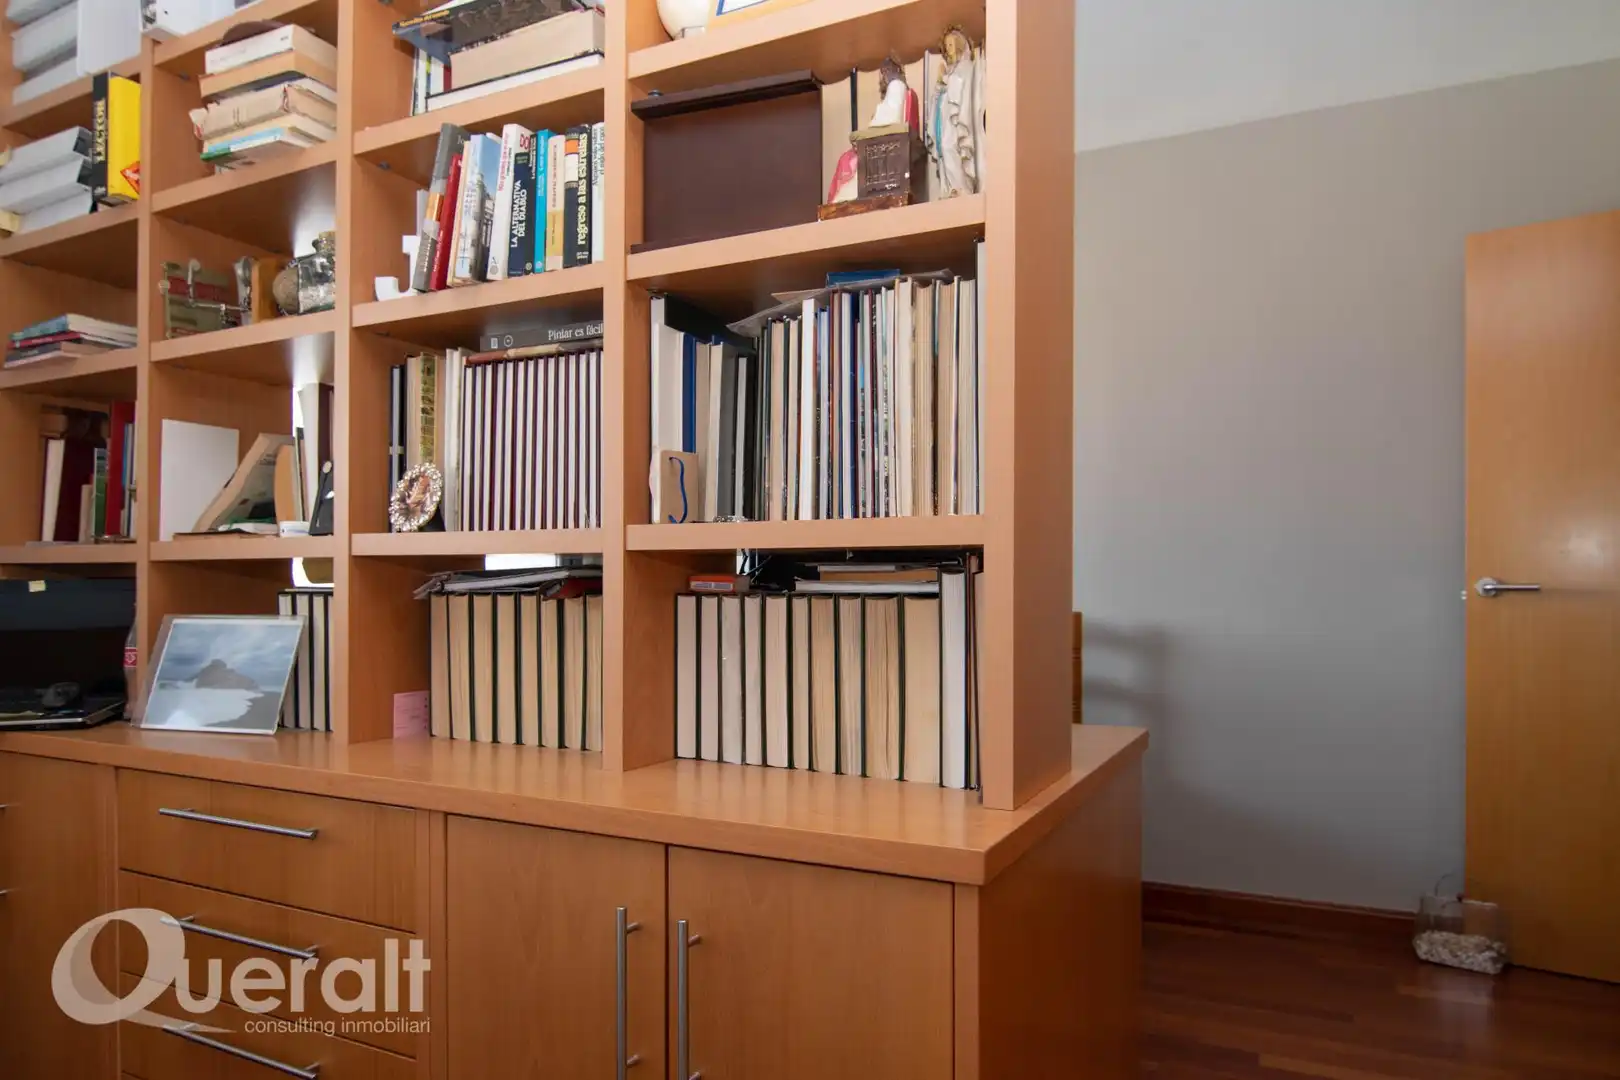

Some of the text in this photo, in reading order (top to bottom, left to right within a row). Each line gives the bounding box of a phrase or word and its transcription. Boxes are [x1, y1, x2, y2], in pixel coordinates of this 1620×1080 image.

[579, 133, 587, 178] estrellas
[577, 179, 586, 195] las
[510, 180, 521, 248] LA ALTERNATIVA
[517, 189, 527, 237] DEL DIABLO
[577, 205, 588, 245] regreso
[548, 323, 603, 341] Pintar es fácil
